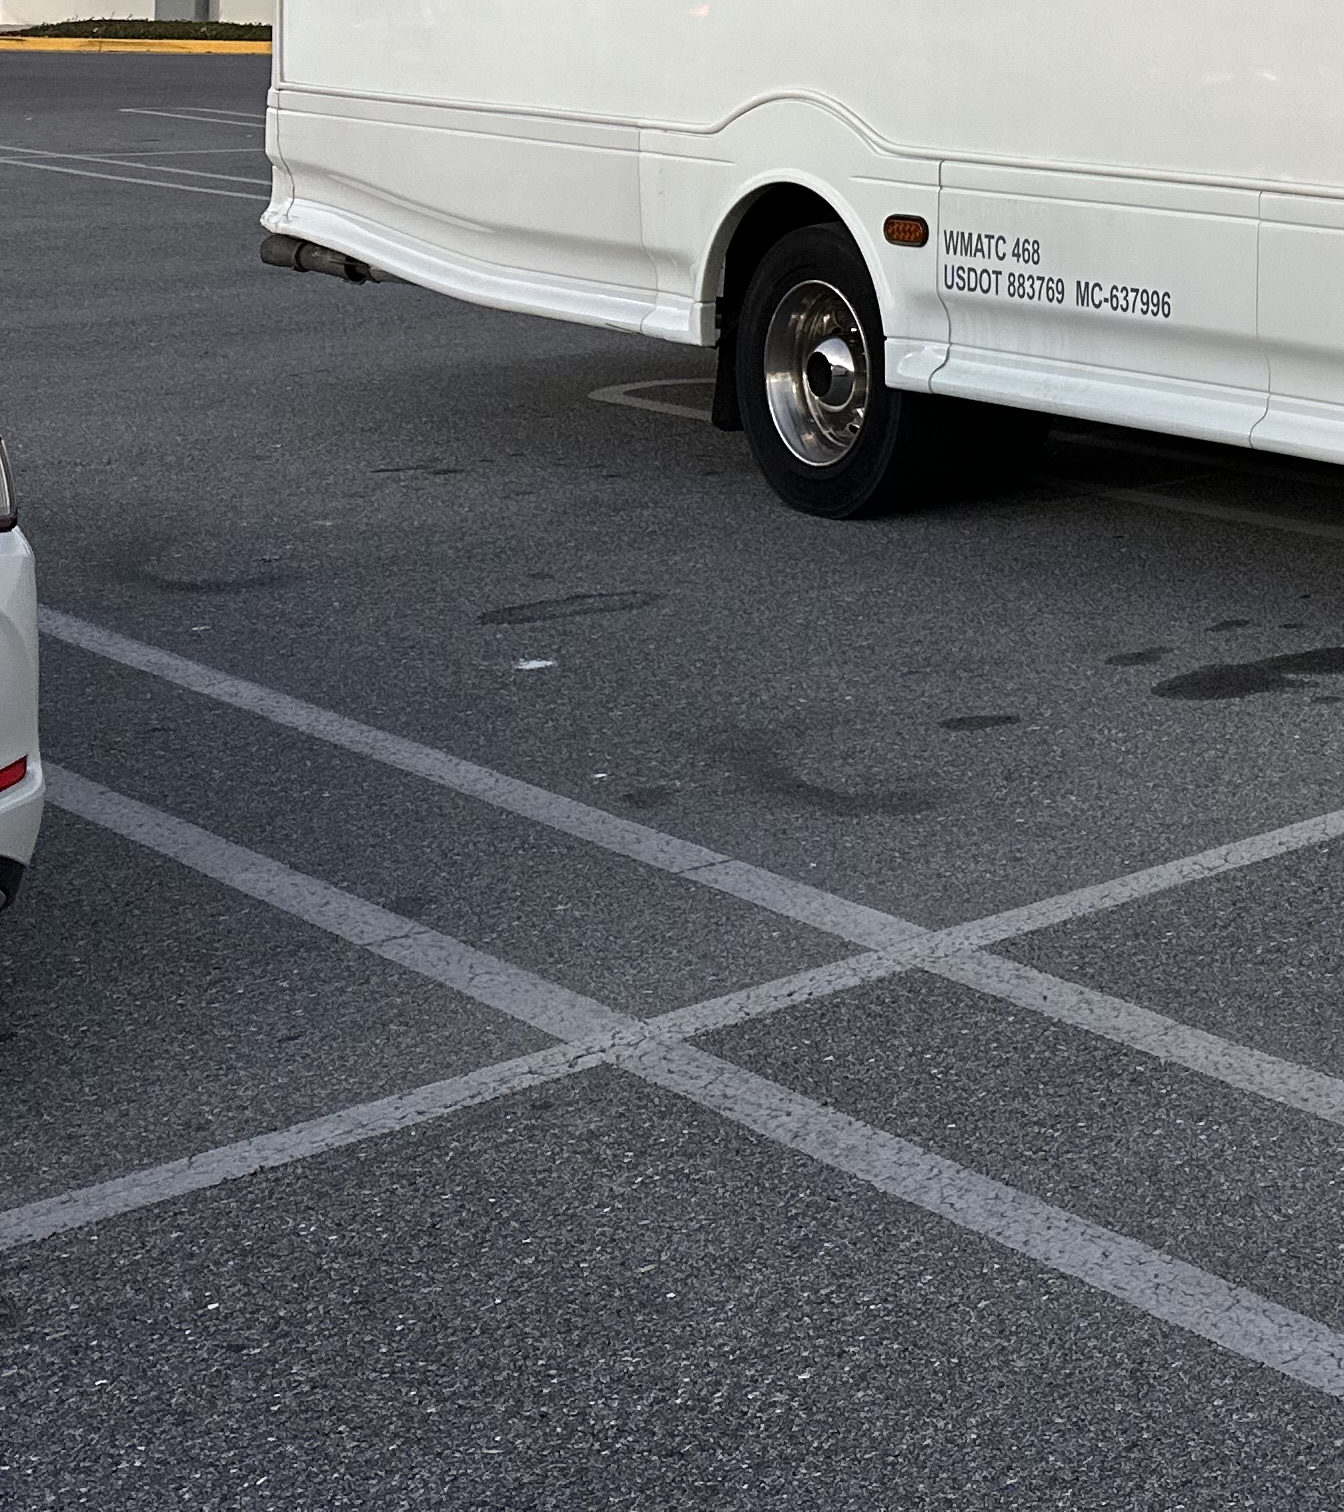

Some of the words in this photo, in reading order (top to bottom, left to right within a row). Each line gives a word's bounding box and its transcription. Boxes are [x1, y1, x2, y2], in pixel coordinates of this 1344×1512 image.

[944, 229, 1007, 262] WMATC
[1011, 238, 1041, 265] 468
[944, 264, 1003, 296] USDOT
[1007, 272, 1065, 304] 883769
[1076, 280, 1171, 318] MC-637996
